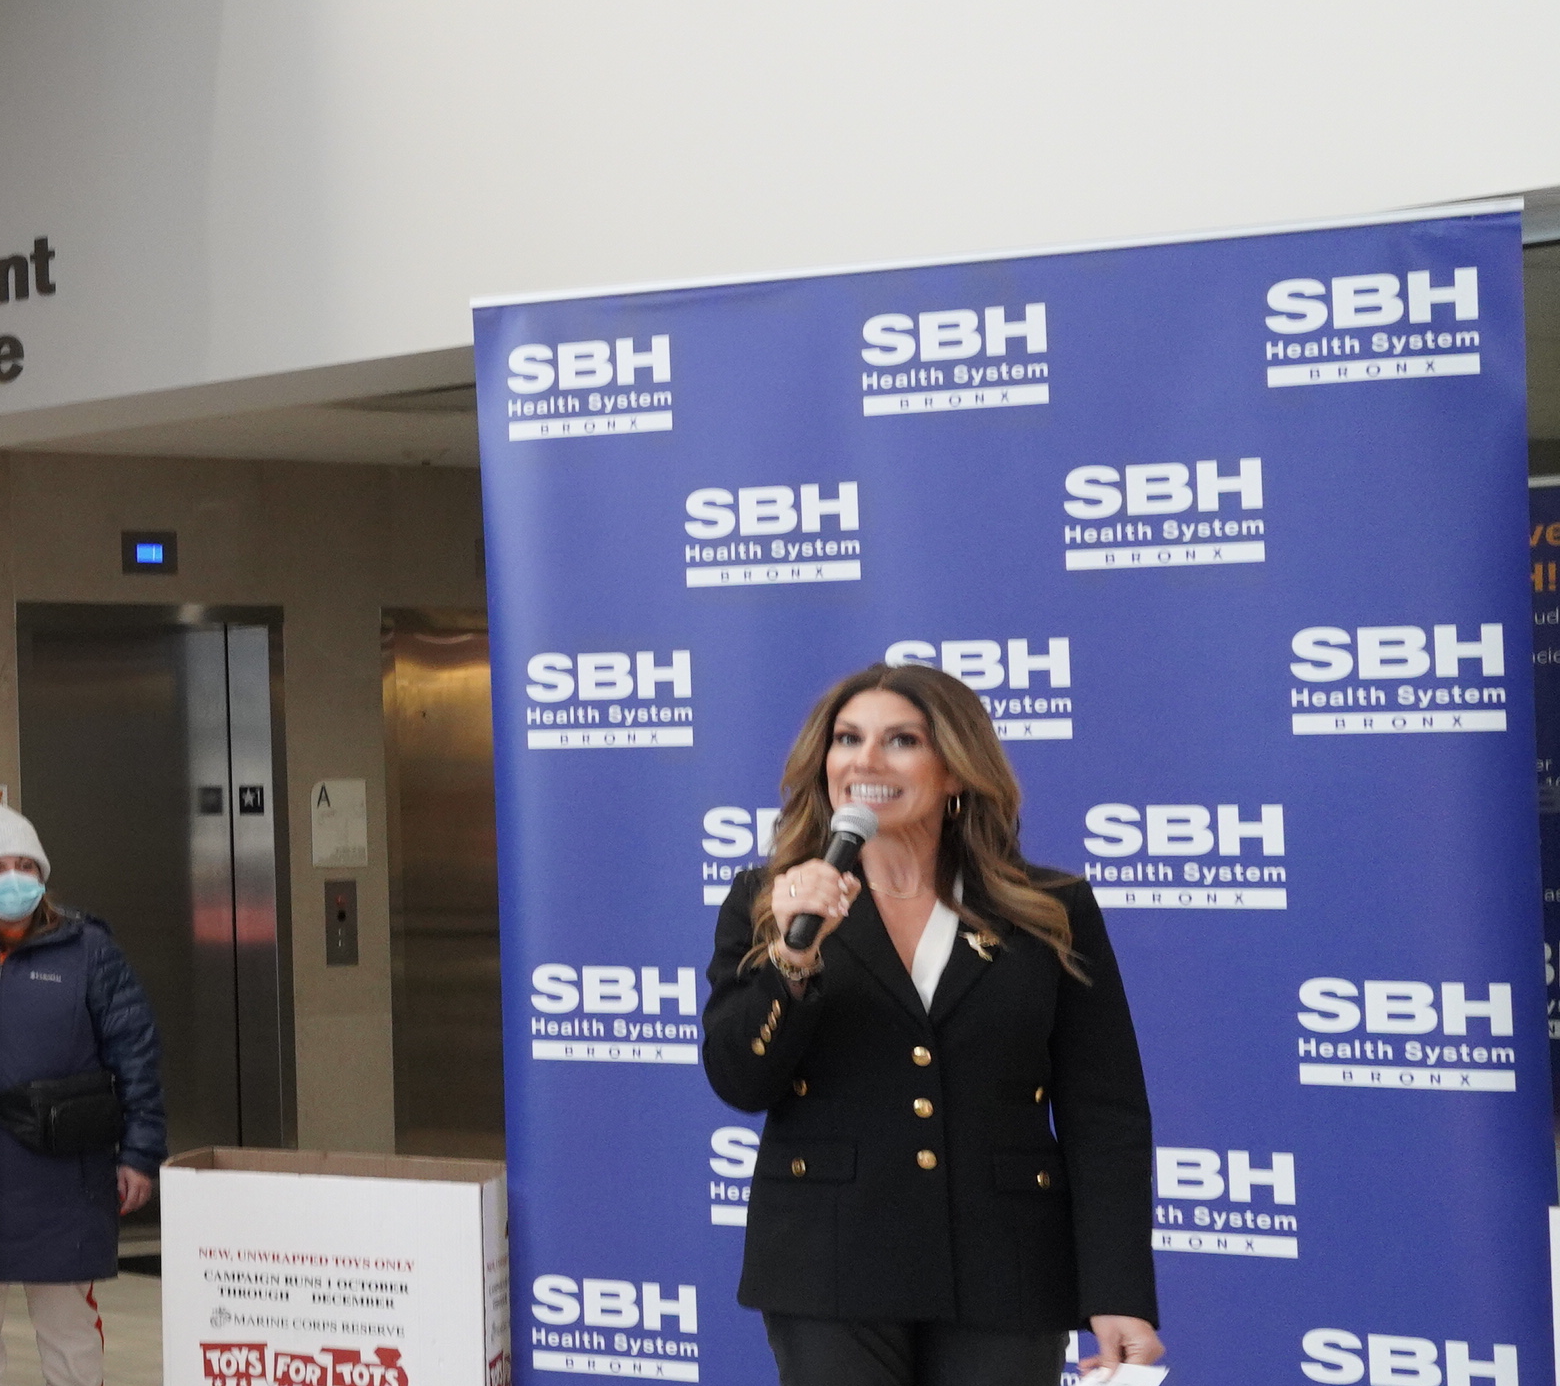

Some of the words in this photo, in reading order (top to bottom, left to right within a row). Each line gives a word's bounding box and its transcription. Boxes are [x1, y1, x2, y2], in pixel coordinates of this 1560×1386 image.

[1265, 267, 1478, 334] SBH
[861, 302, 1047, 366] SBH
[1266, 336, 1359, 360] Health
[1372, 331, 1479, 354] System
[507, 334, 671, 394] SBH
[1307, 359, 1436, 381] BRONX
[862, 367, 943, 391] Health
[954, 363, 1048, 386] System
[508, 395, 579, 417] Health
[588, 391, 672, 413] System
[898, 389, 1010, 411] BRONX
[539, 415, 639, 436] BRONX
[1064, 457, 1263, 519] SBH
[685, 481, 859, 539] SBH
[1065, 522, 1152, 544] Health
[1163, 519, 1264, 542] System
[685, 541, 761, 562] Health
[771, 539, 860, 561] System
[1103, 546, 1224, 565] BRONX
[719, 564, 825, 583] BRONX
[1290, 624, 1504, 682] SBH
[526, 650, 691, 703] SBH
[1291, 687, 1385, 707] Health
[1398, 686, 1505, 708] System
[527, 706, 599, 725] Health
[609, 705, 692, 726] System
[1332, 714, 1462, 730] BRONX
[558, 730, 659, 746] BRONX
[1084, 803, 1284, 857] SBH
[1085, 863, 1172, 881] Health
[1184, 862, 1286, 885] System
[1124, 890, 1245, 905] BRONX
[531, 964, 696, 1015] SBH
[1298, 978, 1513, 1035] SBH
[532, 1018, 604, 1036] Health
[614, 1019, 697, 1040] System
[563, 1044, 664, 1060] BRONX
[1299, 1038, 1392, 1059] Health
[1405, 1041, 1514, 1064] System
[1340, 1068, 1470, 1087] BRONX
[1156, 1147, 1295, 1205] BH
[710, 1181, 751, 1202] Hea
[1194, 1207, 1297, 1230] System
[1162, 1233, 1255, 1252] RONX
[237, 1249, 329, 1267] UNWRAPPED
[332, 1256, 370, 1269] TOYS
[374, 1259, 414, 1273] ONLY
[204, 1269, 280, 1285] CAMPAIGN
[284, 1275, 322, 1289] RUNS
[337, 1278, 409, 1294] OCTOBER
[218, 1284, 290, 1302] THROUGH
[312, 1293, 395, 1310] DECEMBER
[532, 1275, 697, 1333] SBH
[234, 1313, 289, 1329] MARINE
[293, 1317, 337, 1333] CORPS
[342, 1321, 405, 1338] RESERVE
[532, 1328, 605, 1349] Health
[615, 1334, 698, 1357] System
[206, 1345, 263, 1377] TOYS
[276, 1354, 321, 1386] FOR
[564, 1356, 665, 1376] BRONX
